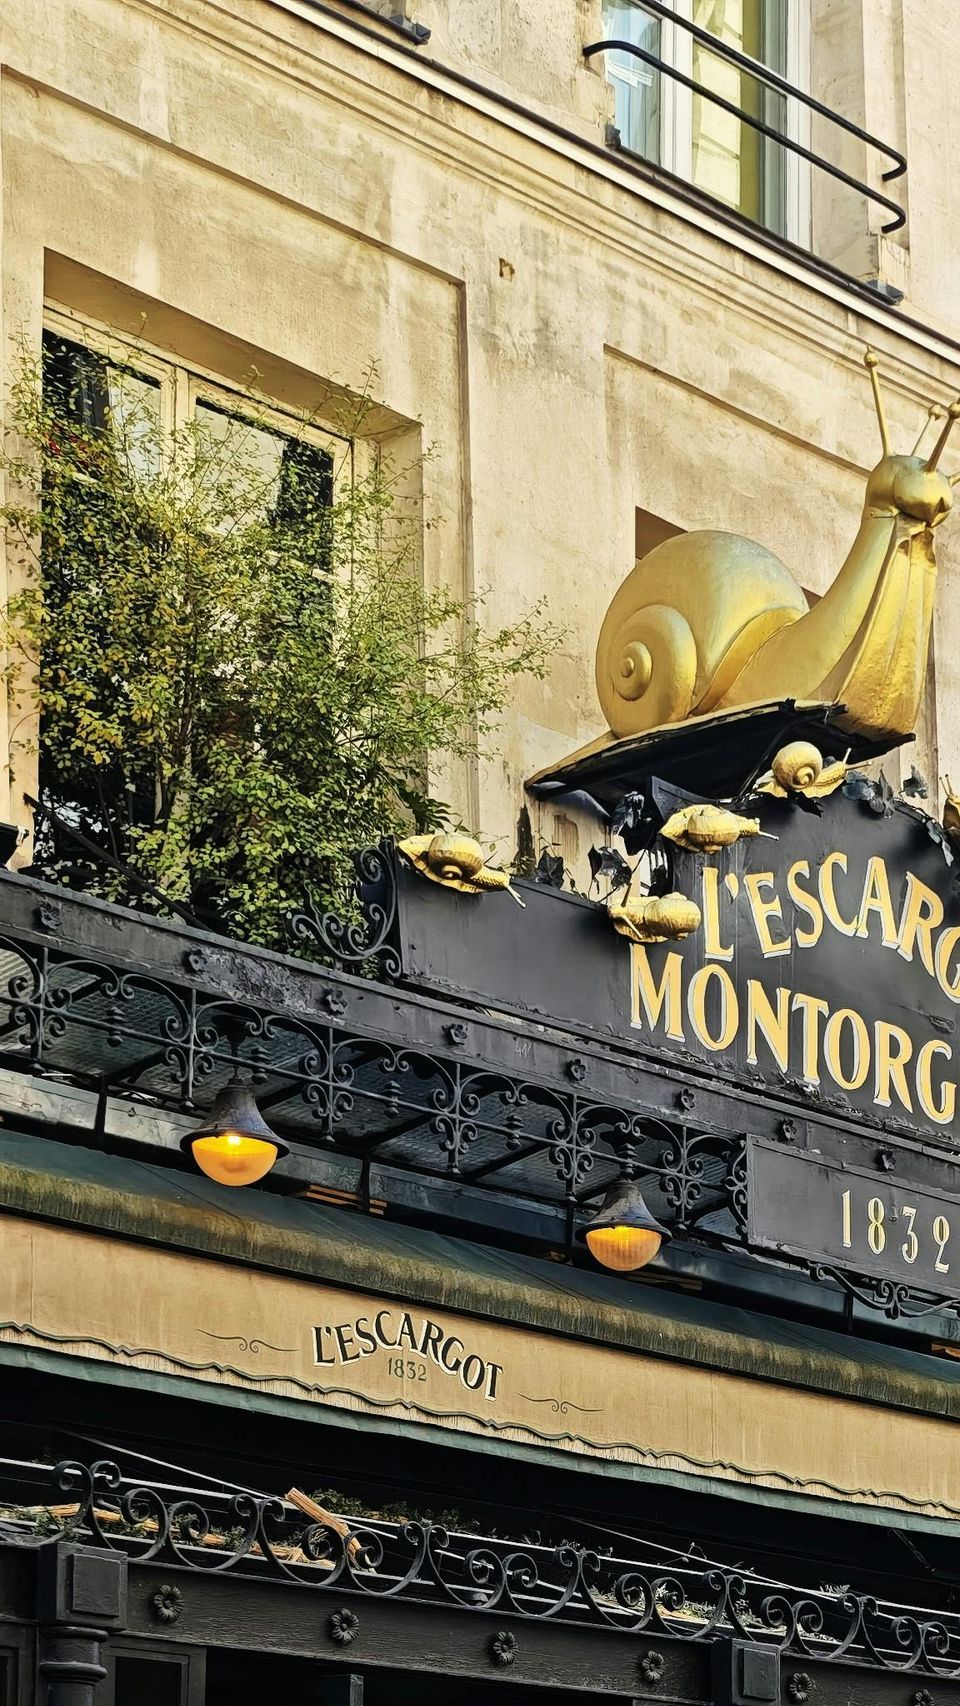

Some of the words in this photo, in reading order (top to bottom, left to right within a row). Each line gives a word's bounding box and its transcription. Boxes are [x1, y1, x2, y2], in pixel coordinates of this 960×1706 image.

[841, 1189, 951, 1274] 1832
[311, 1310, 504, 1402] L'ESCARGOT
[387, 1356, 428, 1382] 1832
